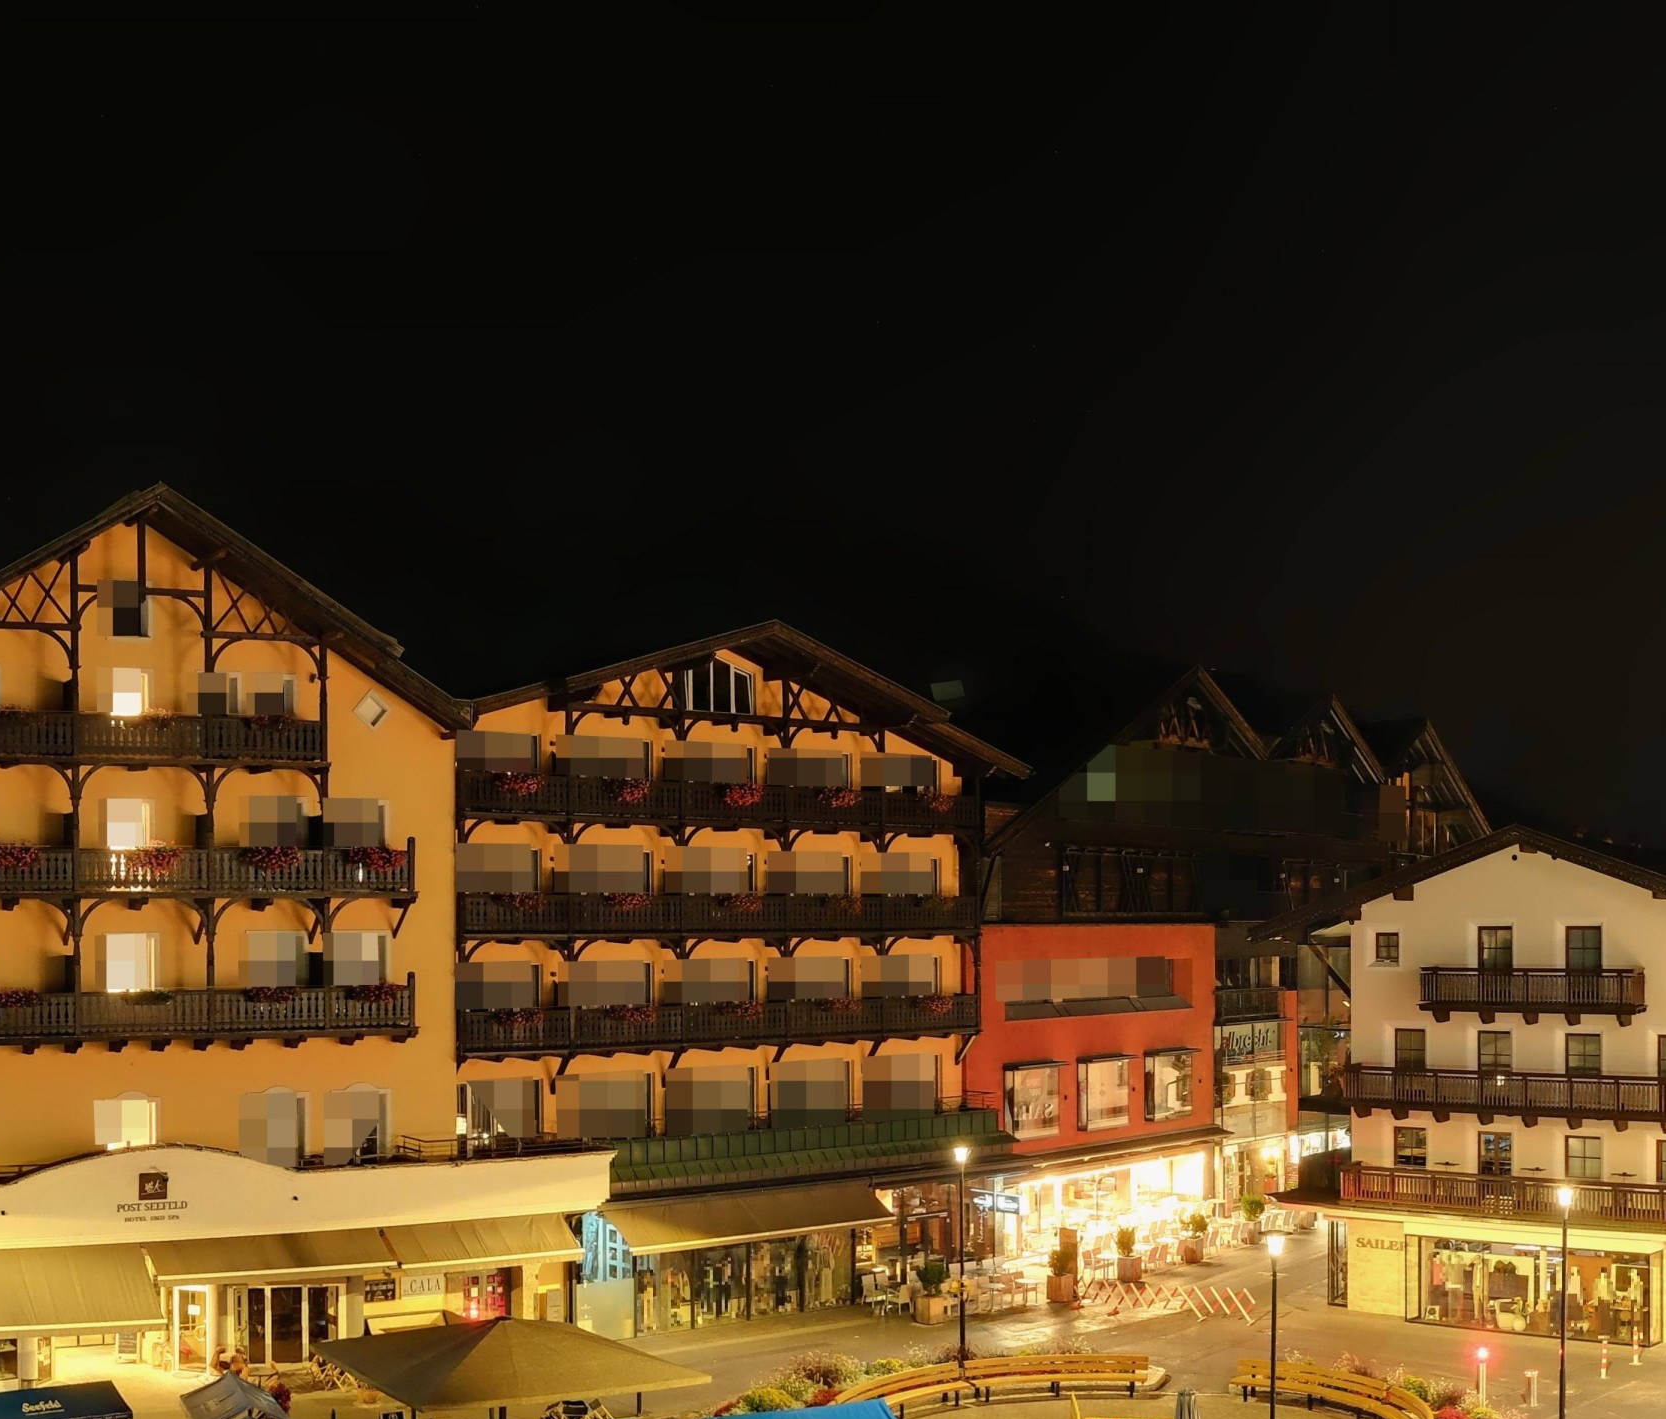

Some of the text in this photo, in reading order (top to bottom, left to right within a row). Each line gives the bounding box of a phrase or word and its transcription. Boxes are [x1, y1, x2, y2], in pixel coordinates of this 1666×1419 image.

[117, 1200, 188, 1212] POST SEEFELD
[410, 1277, 442, 1294] CALA
[22, 1400, 62, 1414] Seefeld
